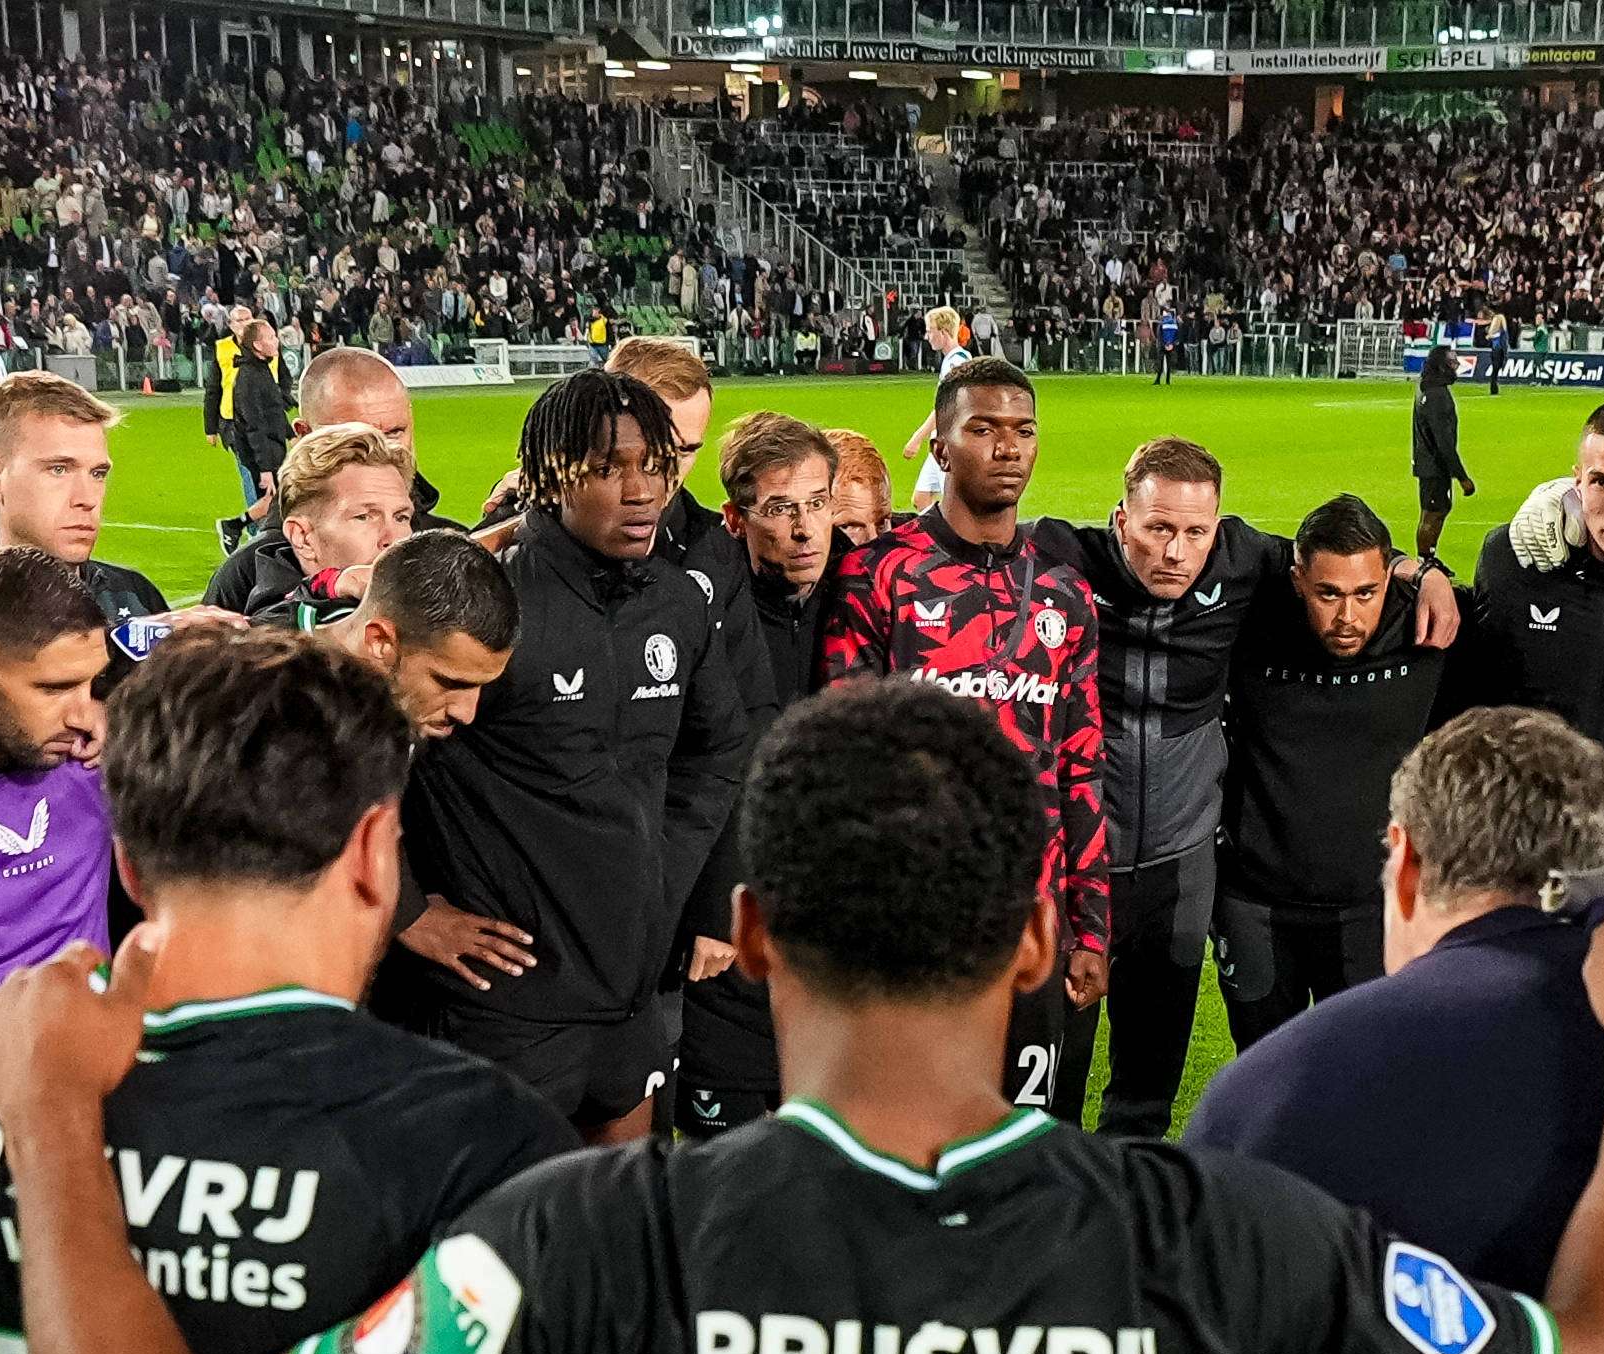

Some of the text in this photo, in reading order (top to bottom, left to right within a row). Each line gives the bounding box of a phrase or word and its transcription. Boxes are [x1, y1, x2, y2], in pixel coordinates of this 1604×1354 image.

[844, 41, 918, 63] Juwelier
[970, 45, 1095, 69] Gelkingestraat
[1249, 50, 1383, 71] installatiebedrijf
[1394, 51, 1488, 69] SCHEPEL
[1265, 664, 1409, 687] FEYENOORD
